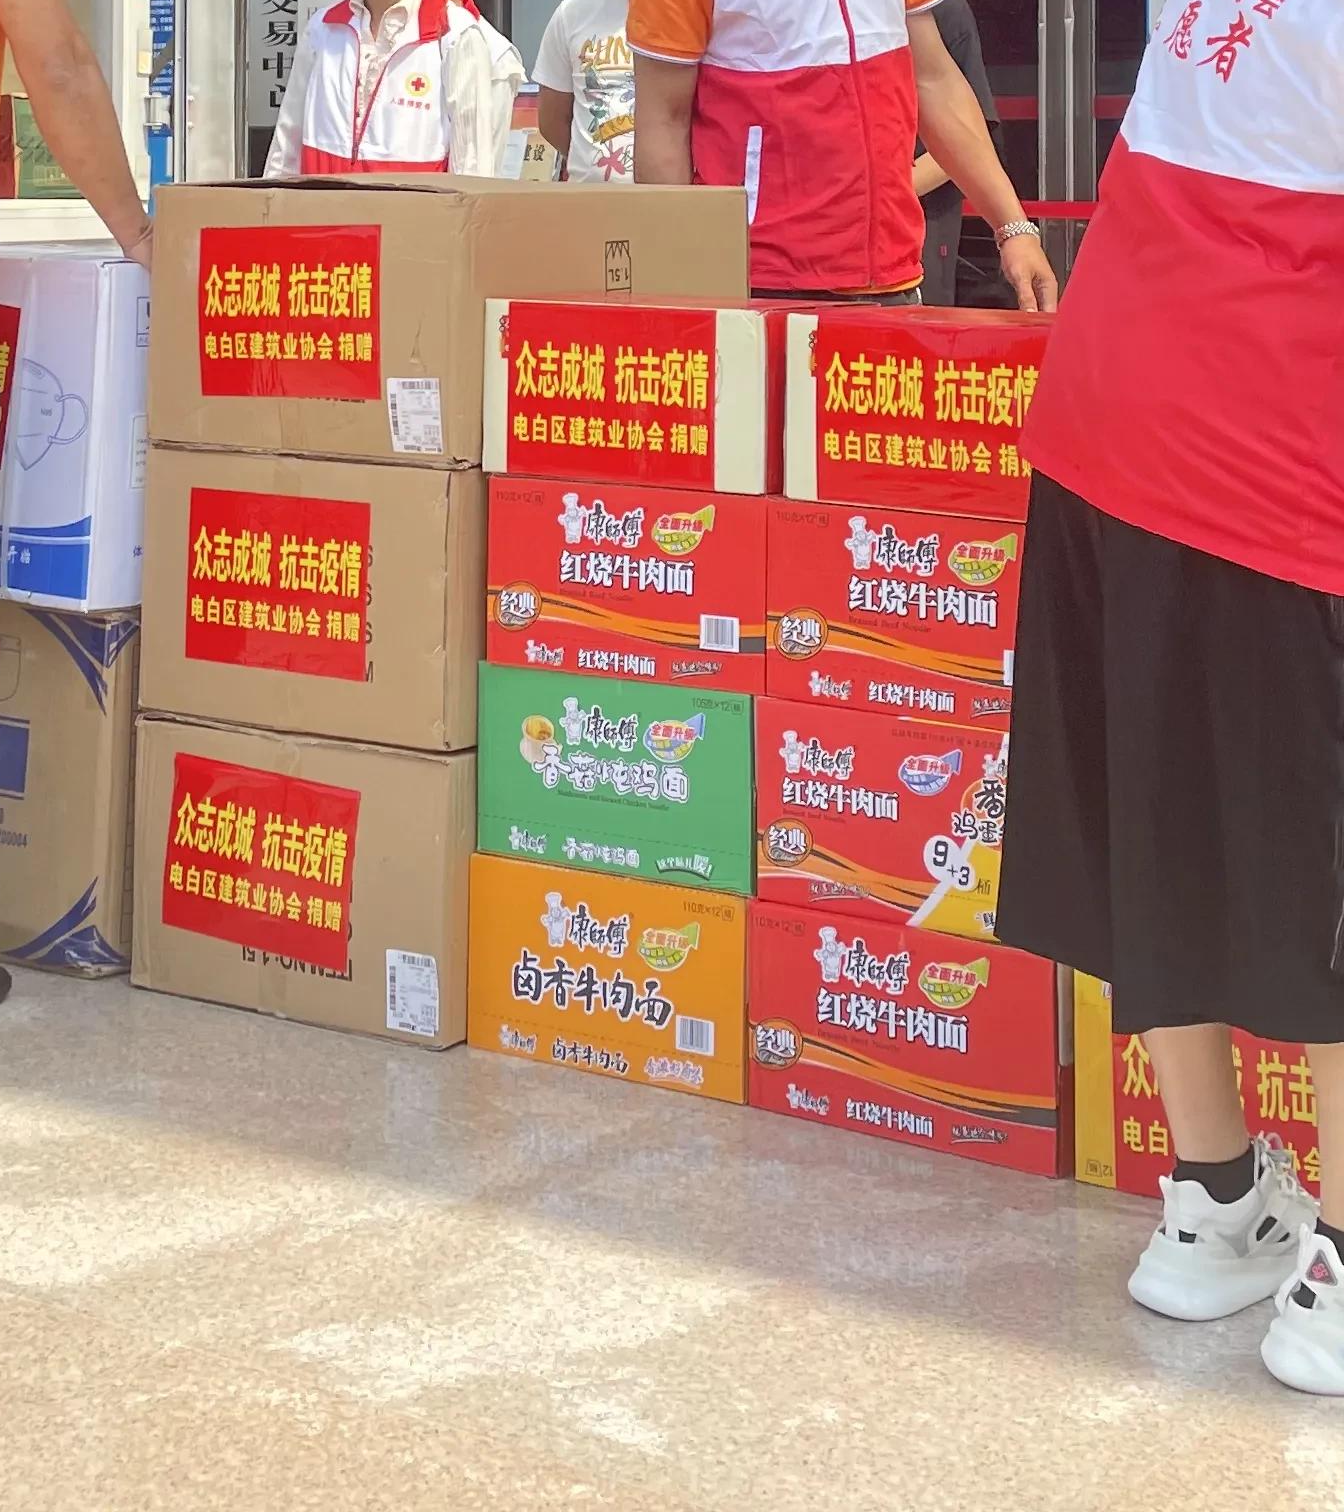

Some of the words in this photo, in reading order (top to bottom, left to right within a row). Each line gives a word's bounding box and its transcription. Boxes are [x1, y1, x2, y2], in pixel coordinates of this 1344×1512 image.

[203, 264, 280, 317] 众志成城
[285, 262, 372, 316] 抗击疫情
[203, 331, 332, 360] 电白区建筑业协会
[336, 331, 372, 361] 捐赠
[513, 341, 605, 400] 众志成城
[612, 347, 708, 408] 抗击疫情
[823, 351, 924, 416] 众志成城
[511, 412, 663, 451] 电白区建筑业协会
[668, 422, 708, 454] 捐赠
[822, 429, 990, 473] 电白区建筑业协会
[191, 527, 272, 584] 众志成城
[276, 536, 361, 596] 抗击疫情
[560, 550, 694, 597] 红烧牛肉面
[188, 595, 320, 635] 电白区建筑业协会
[324, 594, 360, 641] 捐赠
[500, 591, 537, 616] 经典
[848, 577, 998, 629] 红烧牛肉面
[780, 618, 821, 645] 经典
[577, 648, 656, 677] 红烧牛肉面
[868, 682, 955, 715] 红烧牛肉面
[534, 744, 689, 803] 香菇炖鸡面
[782, 778, 900, 822] 红烧牛肉面
[174, 792, 256, 865] 众志成城
[262, 812, 348, 888] 抗击疫情
[767, 826, 807, 852] 经典
[169, 861, 302, 921] 电白区建筑业协会
[307, 895, 343, 932] 捐赠
[513, 951, 672, 1029] 卤香牛肉面
[756, 1028, 797, 1055] 经典
[817, 990, 968, 1054] 红烧牛肉面
[552, 1037, 629, 1076] 卤香牛肉面
[846, 1098, 934, 1139] 红烧牛肉面
